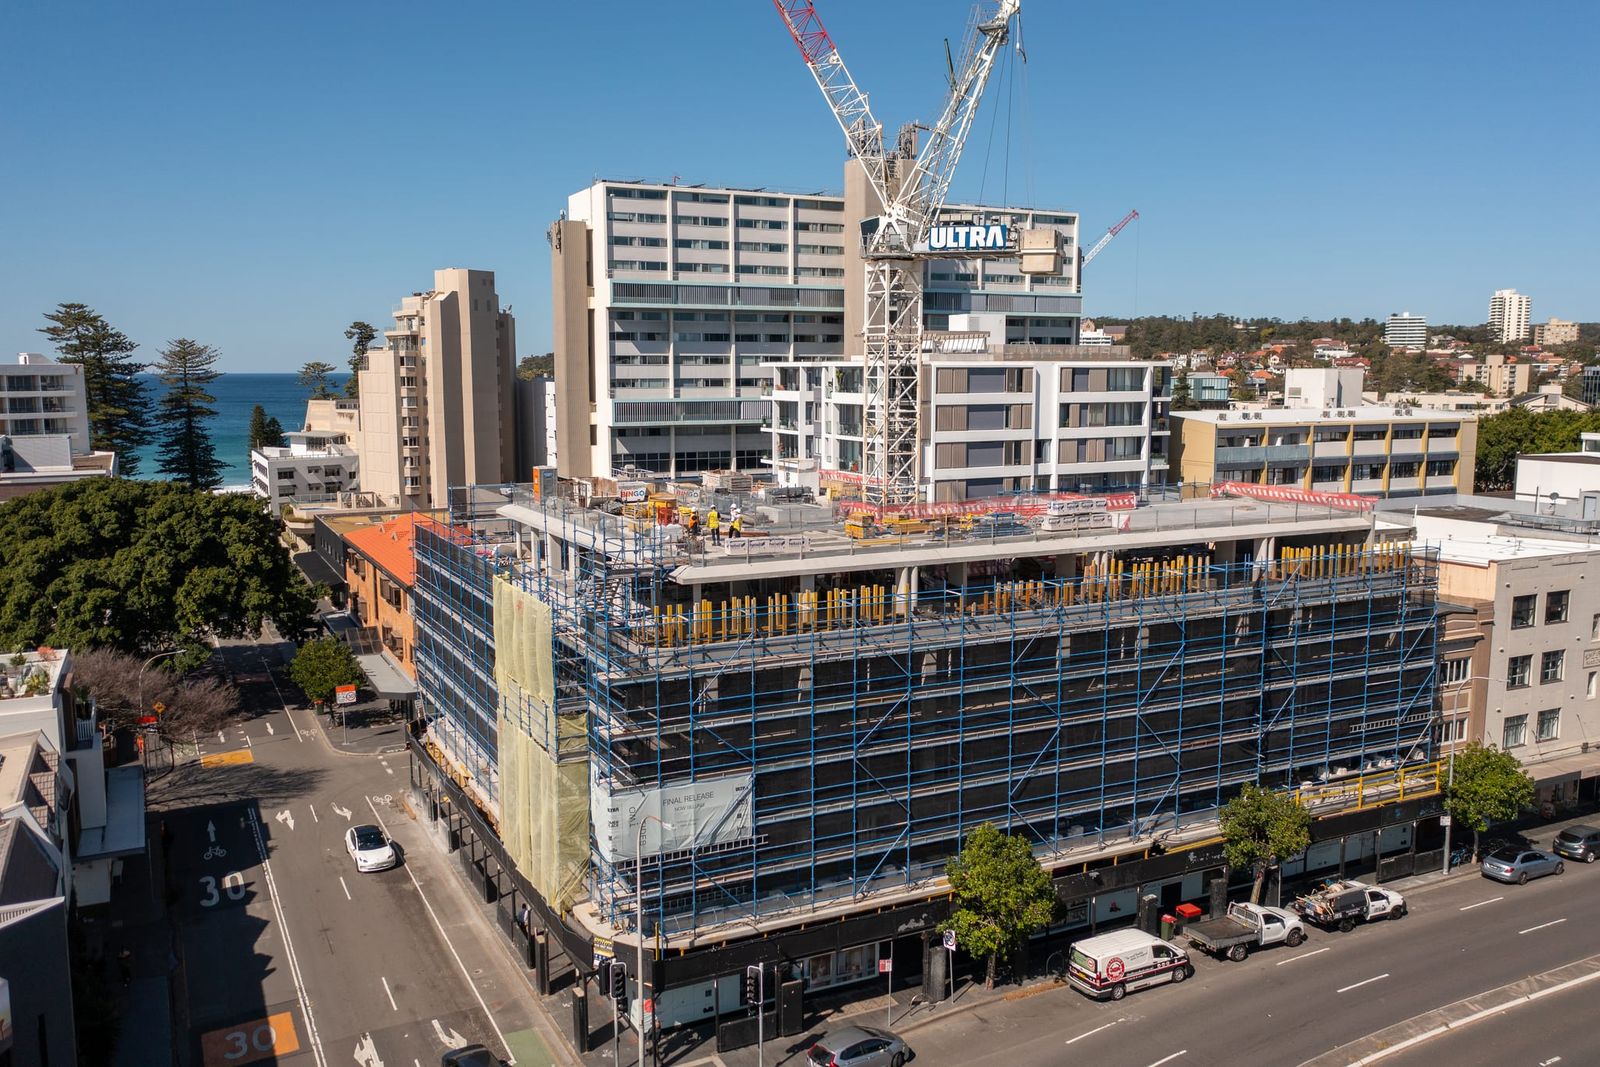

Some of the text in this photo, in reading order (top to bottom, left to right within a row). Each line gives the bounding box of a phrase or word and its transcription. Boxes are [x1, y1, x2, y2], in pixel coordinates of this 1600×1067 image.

[930, 226, 1004, 248] ULTRA
[621, 489, 645, 498] BINGO
[663, 791, 714, 806] FINAL RELEASE
[199, 871, 246, 907] 30
[224, 1024, 276, 1060] 30
